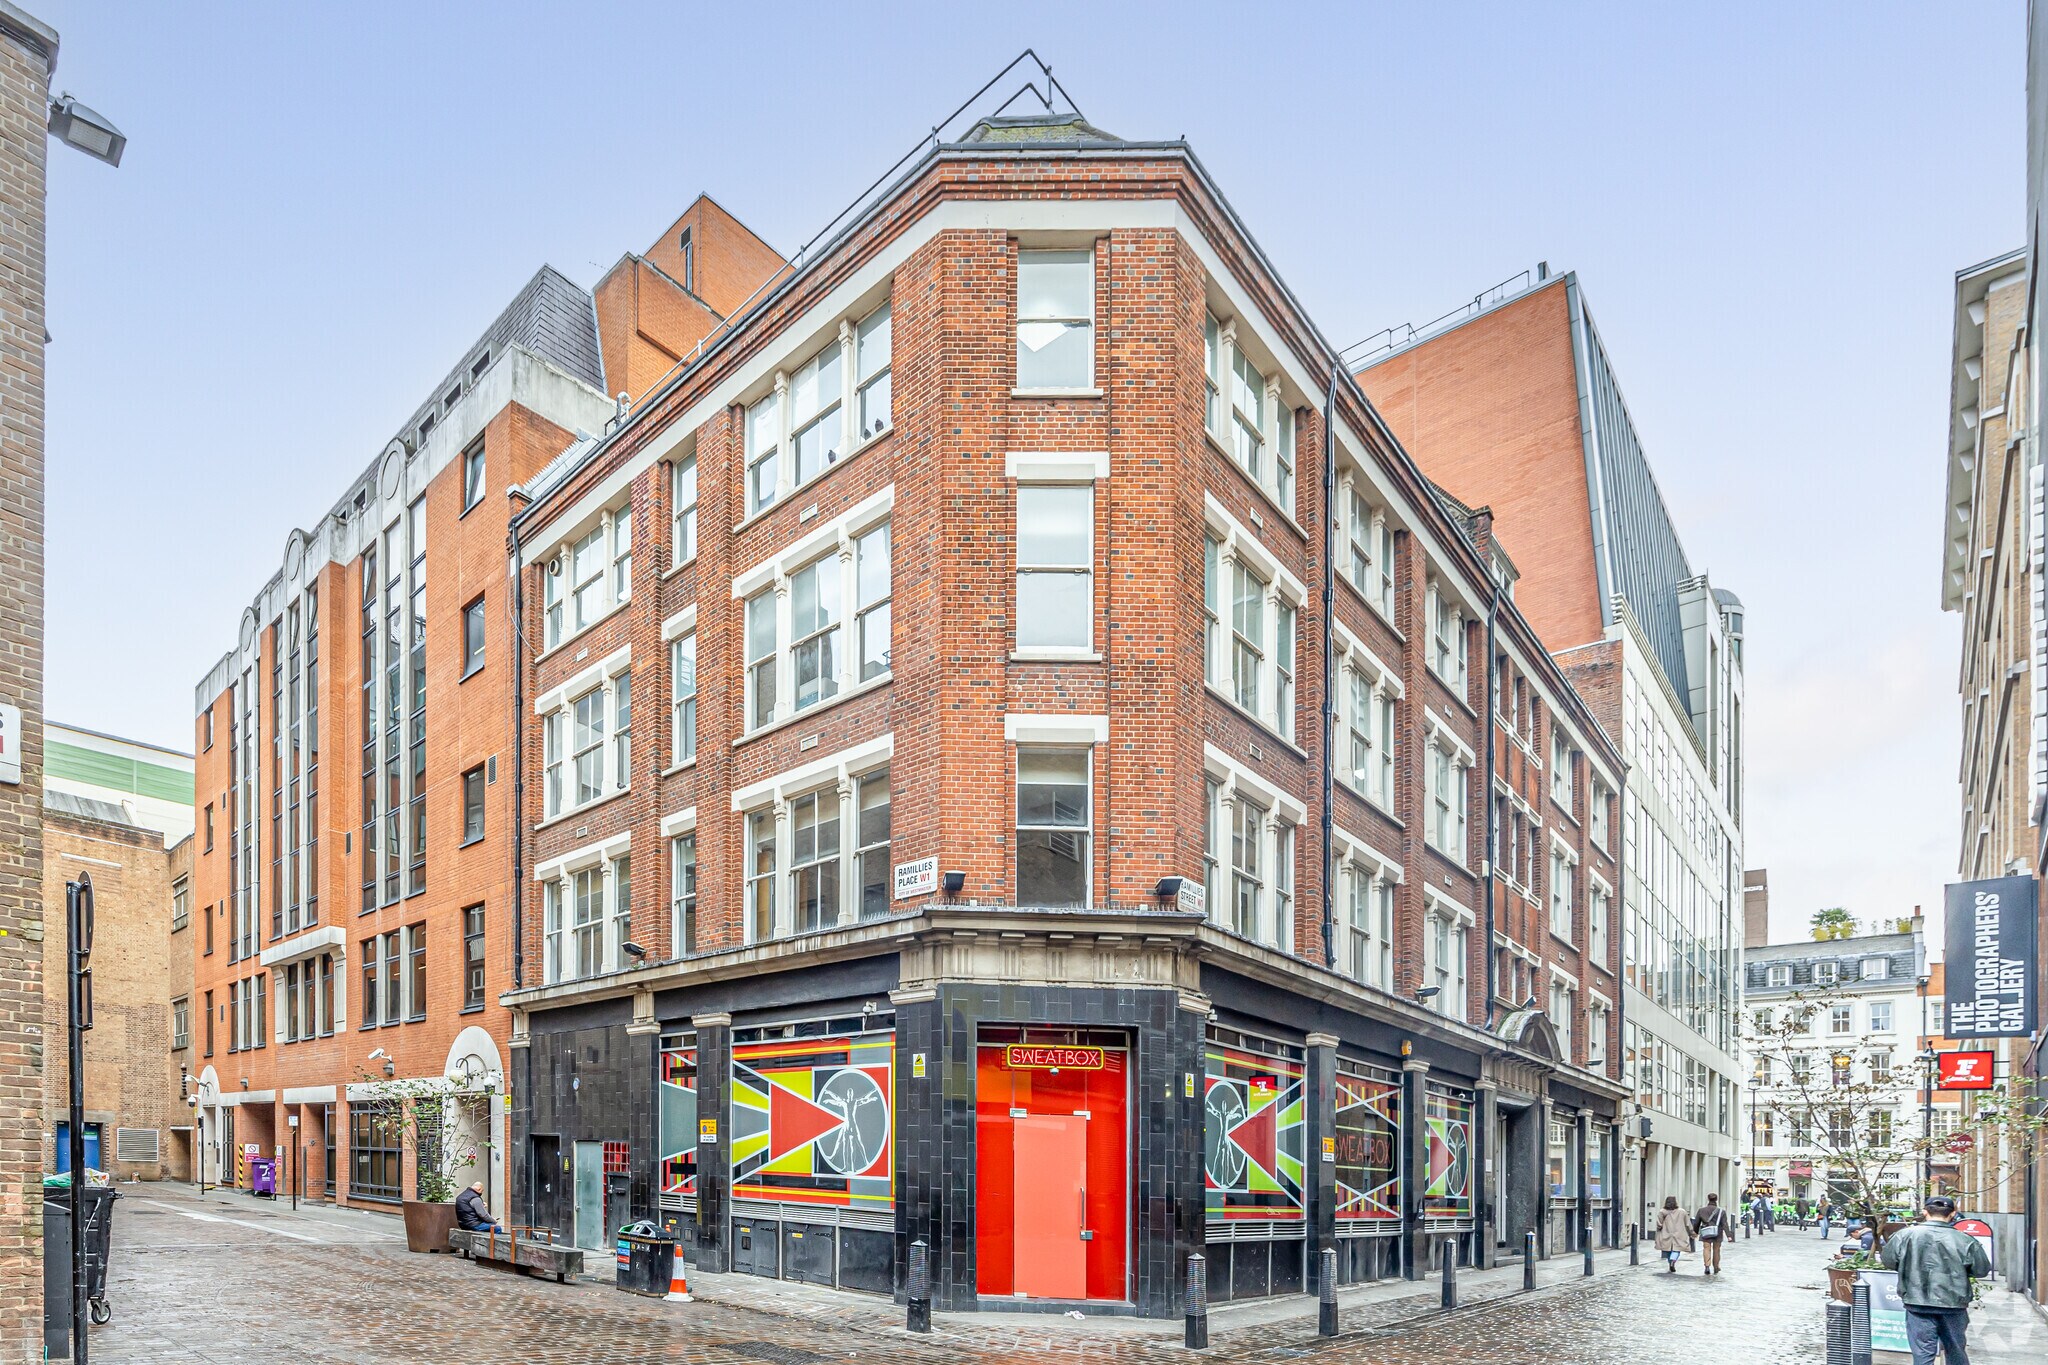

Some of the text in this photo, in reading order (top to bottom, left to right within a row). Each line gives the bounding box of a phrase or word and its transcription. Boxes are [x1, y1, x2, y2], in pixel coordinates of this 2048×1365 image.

[898, 861, 932, 877] RAMILLIES
[898, 872, 930, 887] PLACE W1
[1181, 890, 1196, 904] STREET
[1999, 958, 2025, 1032] GALLERY
[1951, 1001, 1975, 1034] THE
[1011, 1048, 1099, 1066] SWEATBOX
